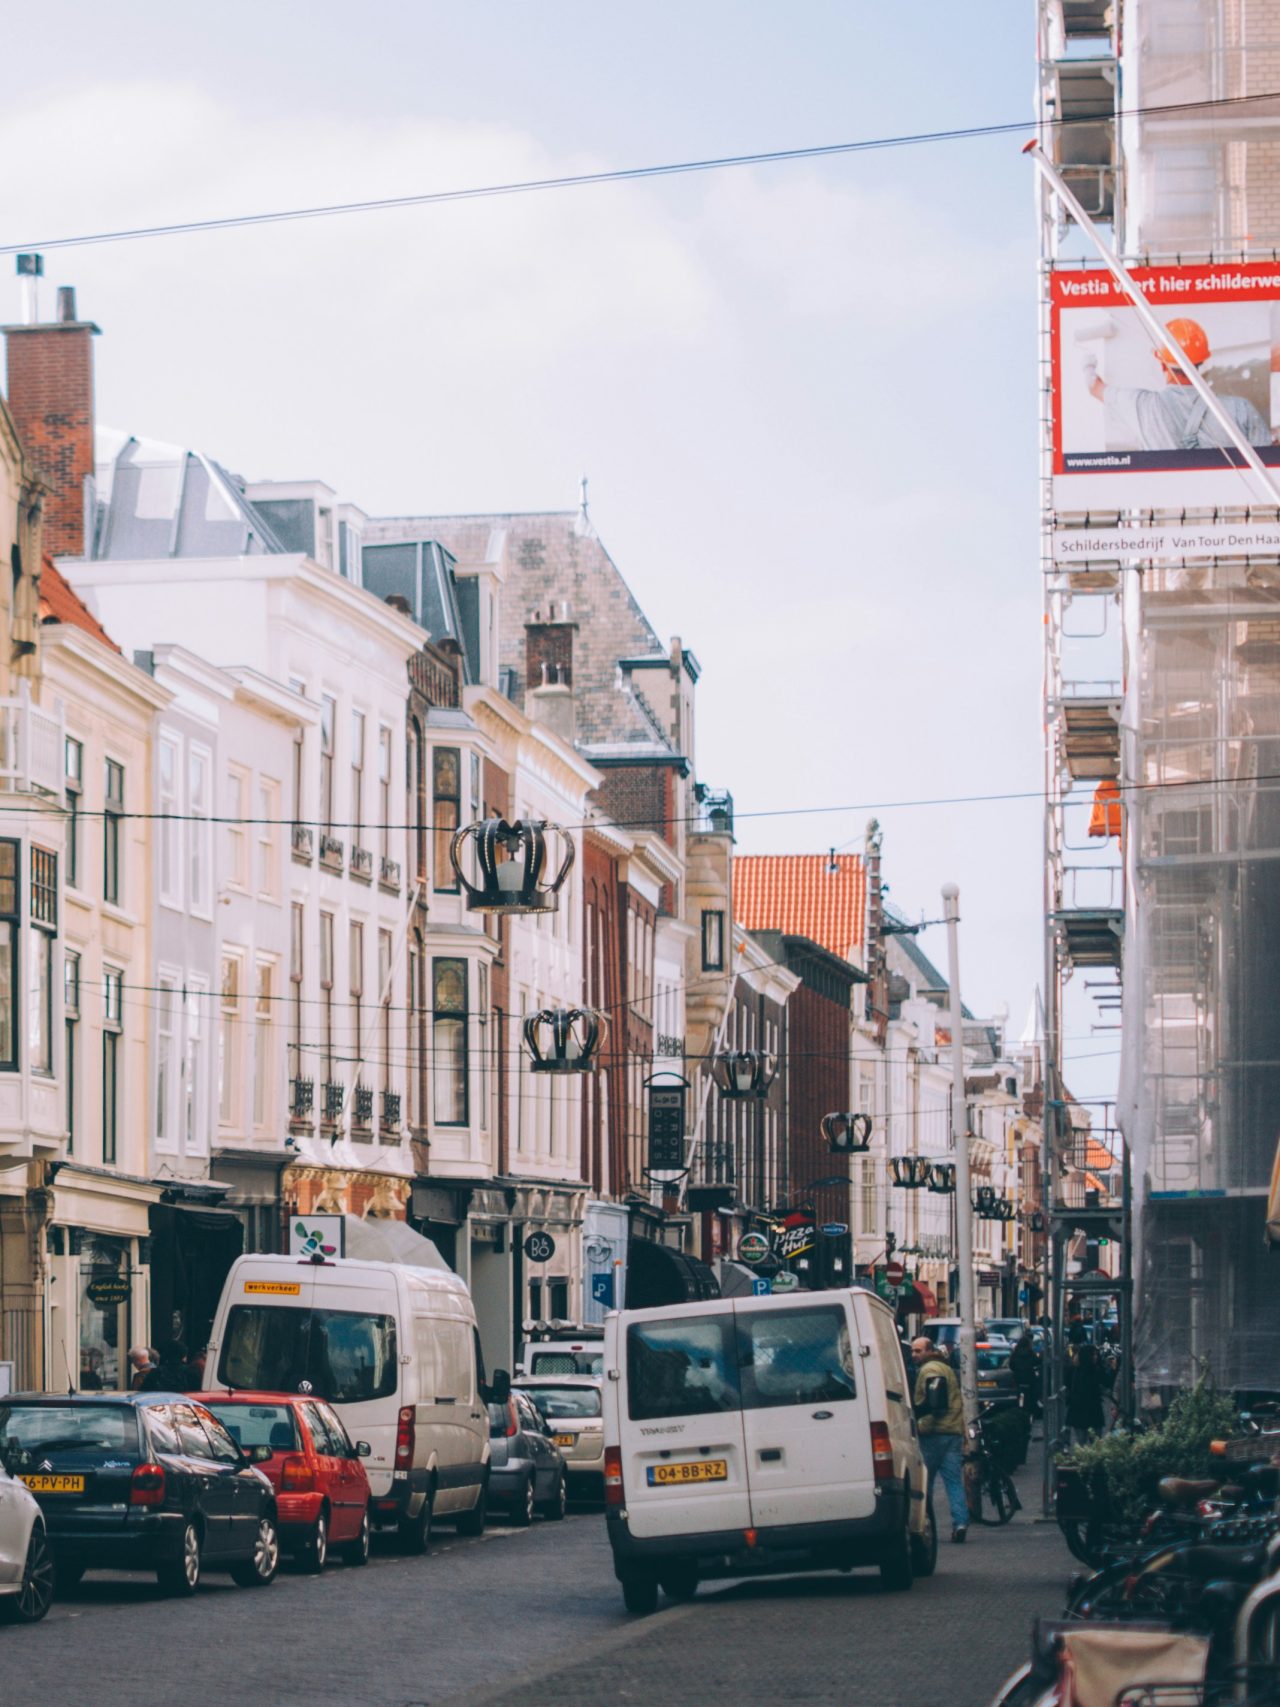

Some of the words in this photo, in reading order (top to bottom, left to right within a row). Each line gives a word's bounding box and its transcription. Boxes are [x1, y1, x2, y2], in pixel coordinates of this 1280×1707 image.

[1059, 278, 1110, 296] Vestia
[1160, 275, 1192, 292] hier
[1066, 455, 1131, 468] www.vestia.nl
[1061, 536, 1165, 553] Schildersbedrijf
[1172, 536, 1196, 549] Van
[1197, 535, 1225, 548] Tour
[1228, 534, 1253, 546] Den
[781, 1235, 812, 1256] Hut
[247, 1284, 297, 1294] werkverkeer
[658, 1463, 723, 1481] 04-BB-RZ
